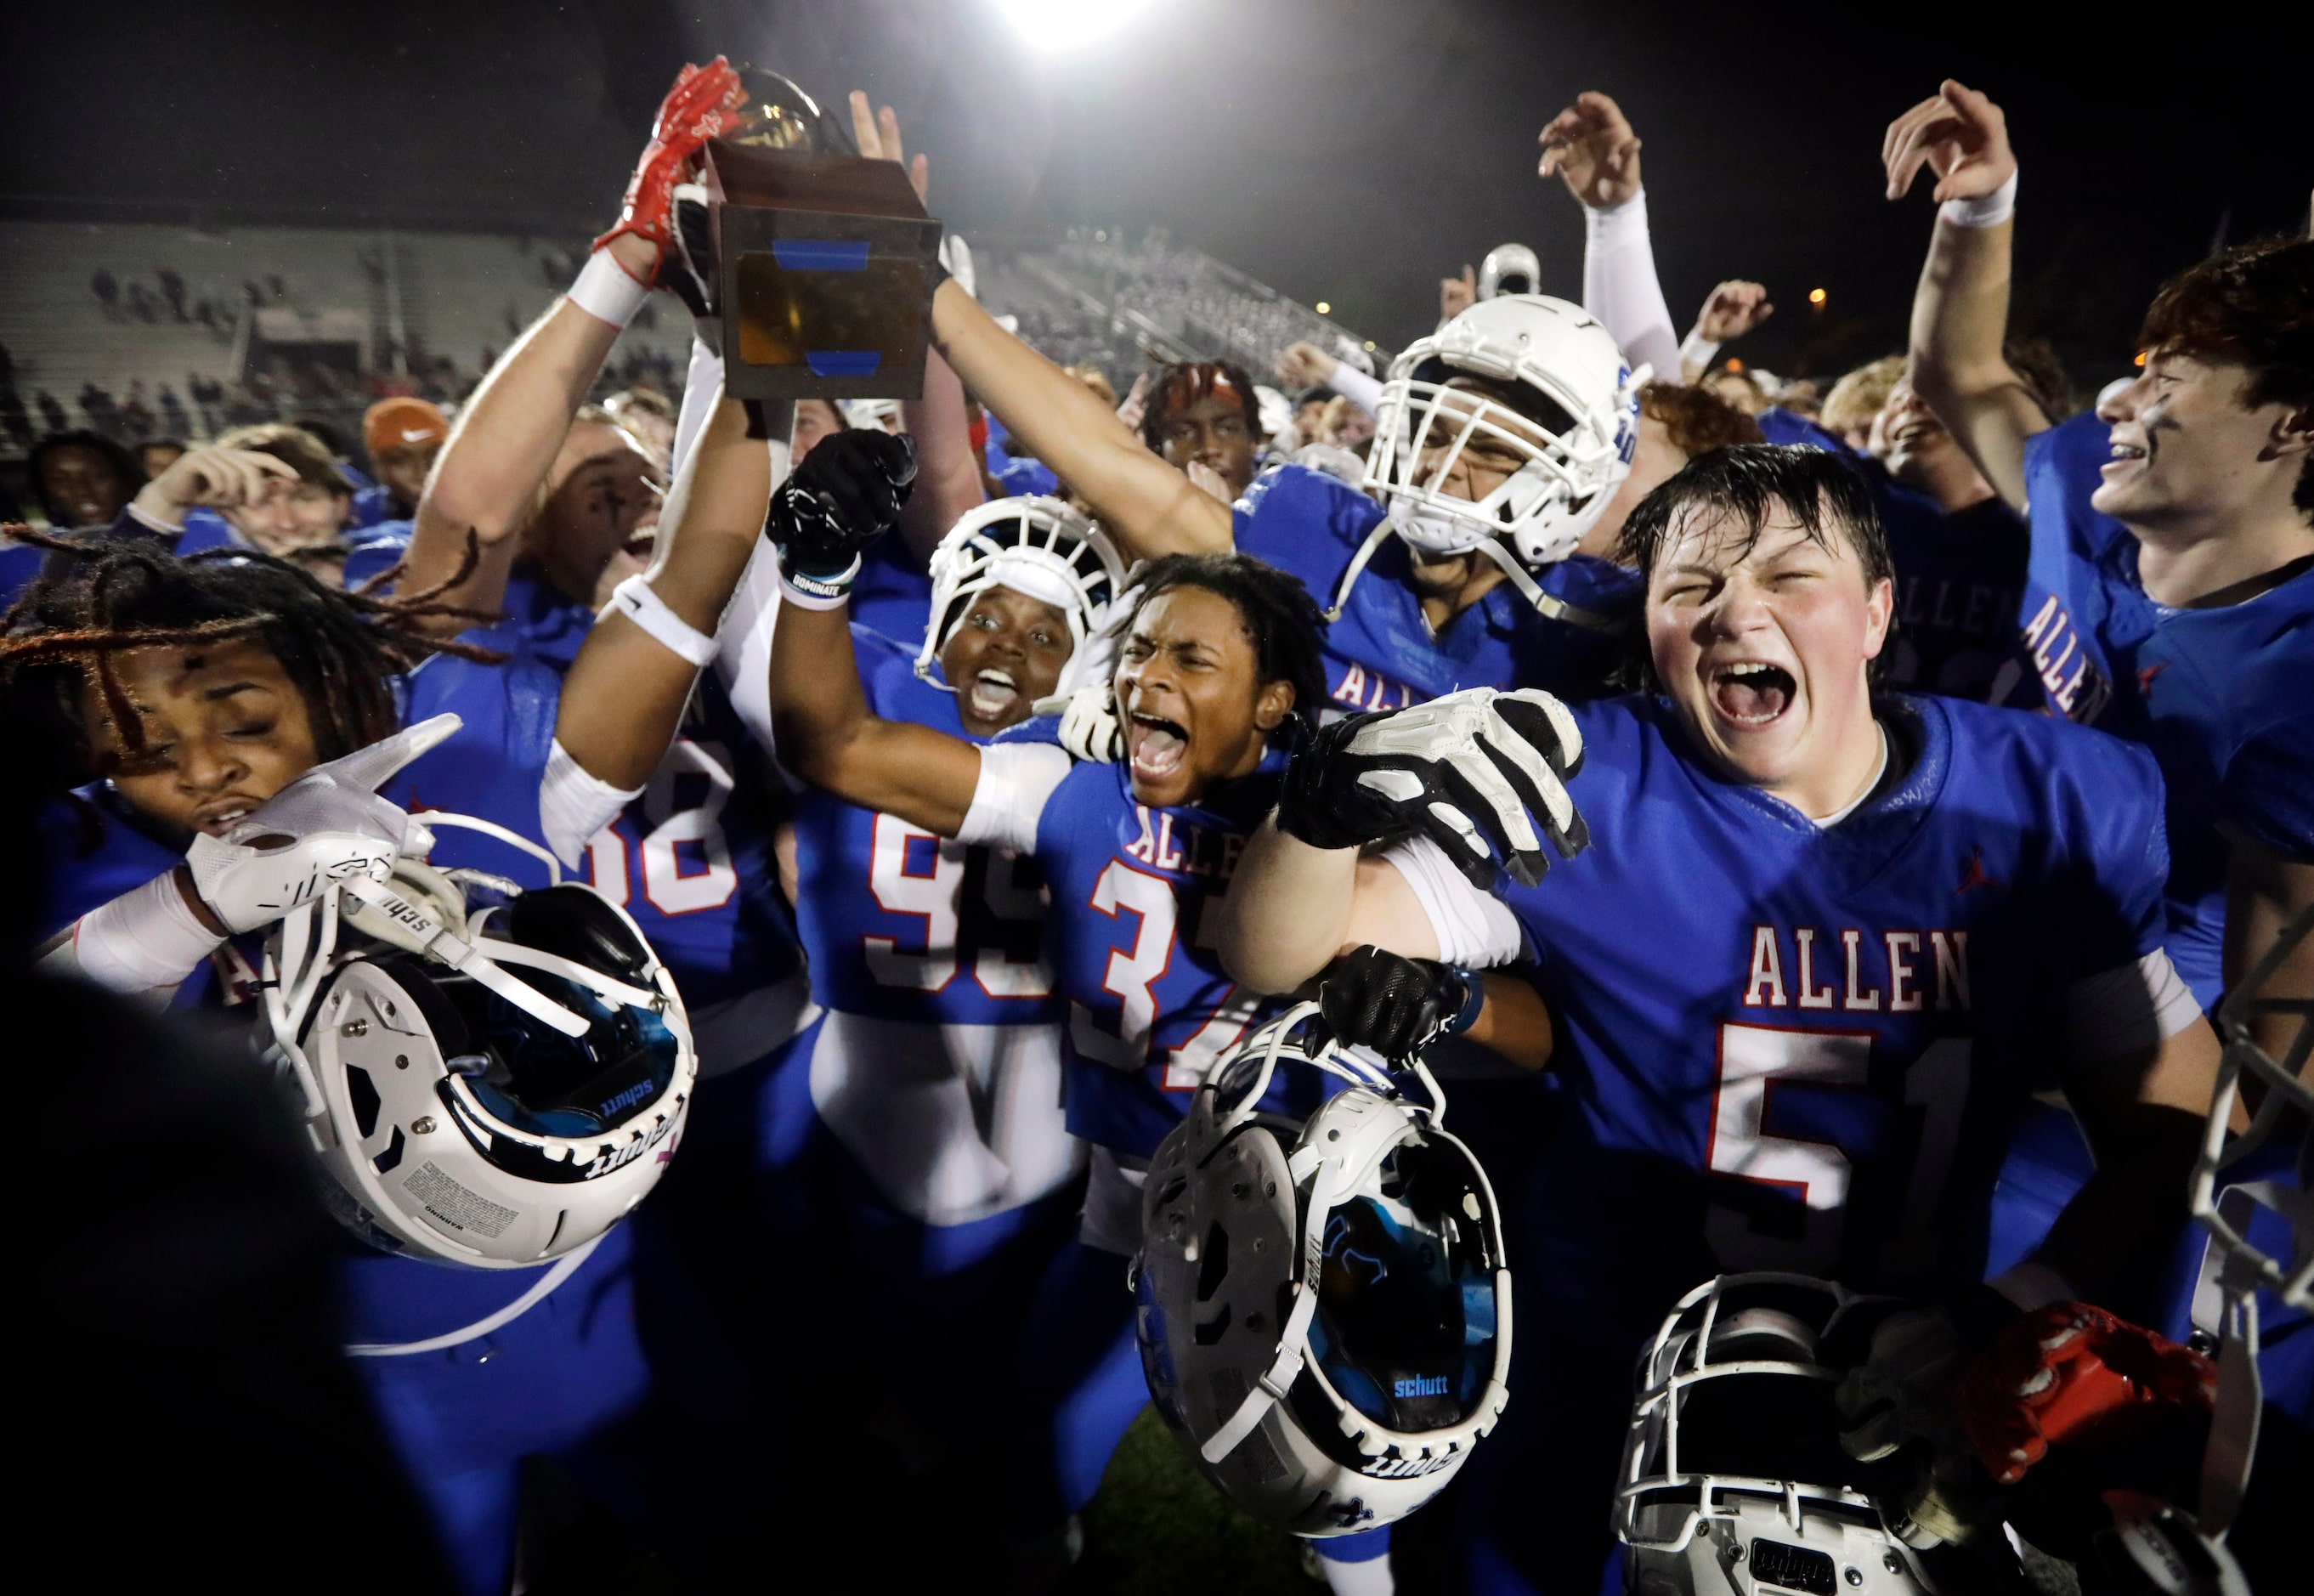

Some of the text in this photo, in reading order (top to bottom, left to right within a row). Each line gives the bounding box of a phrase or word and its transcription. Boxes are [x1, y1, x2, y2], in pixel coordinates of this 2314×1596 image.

[792, 573, 840, 597] DOMINATE
[2021, 595, 2110, 724] ALLEN
[1124, 804, 1248, 882] ALLE
[861, 812, 1057, 999] 99
[1064, 856, 1256, 1092] 37
[1743, 924, 1972, 1014] ALLEN
[600, 1078, 653, 1118] schutt
[1700, 1019, 1974, 1282] 51
[423, 1205, 464, 1232] WARNING
[1394, 1373, 1448, 1399] schutt
[1360, 1452, 1462, 1478] chutt
